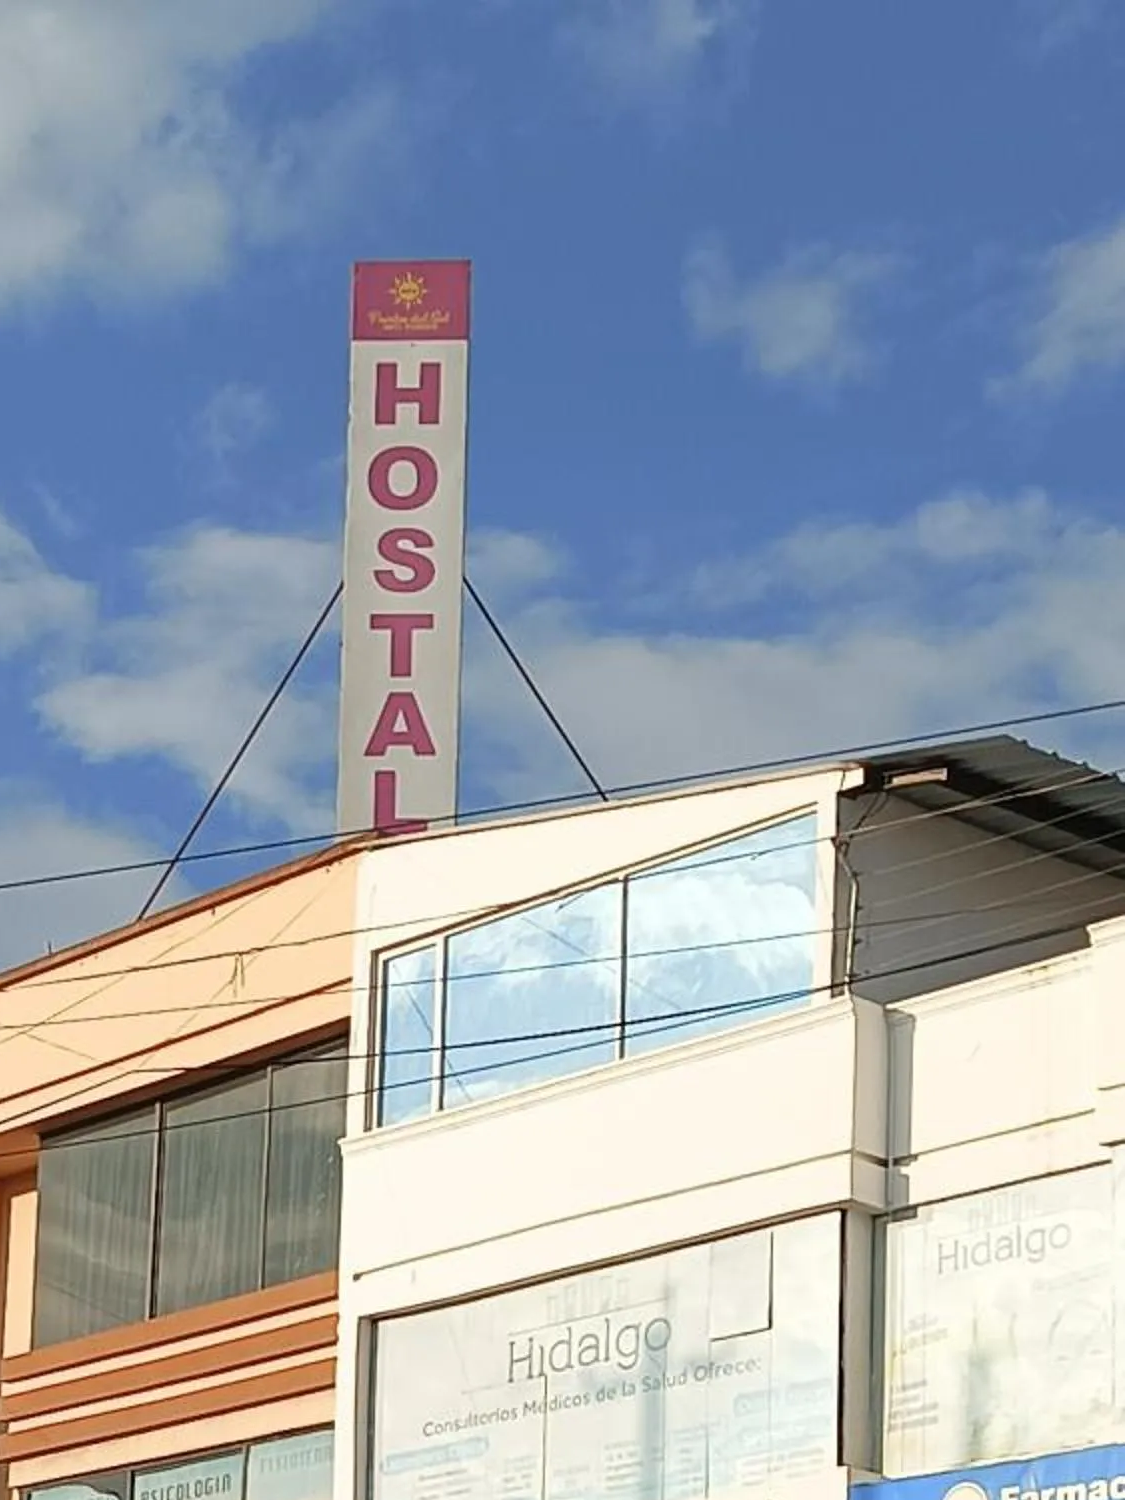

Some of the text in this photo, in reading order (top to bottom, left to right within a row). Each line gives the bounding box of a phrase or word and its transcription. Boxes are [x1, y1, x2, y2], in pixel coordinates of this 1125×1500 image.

[364, 362, 442, 835] HOSTAL
[938, 1223, 1072, 1275] Hidalgo
[507, 1317, 672, 1384] Hidalgo
[422, 1405, 519, 1438] Consultorios
[595, 1383, 618, 1403] de
[622, 1380, 637, 1397] la
[642, 1371, 688, 1393] Salud
[694, 1359, 763, 1383] Ofrece:
